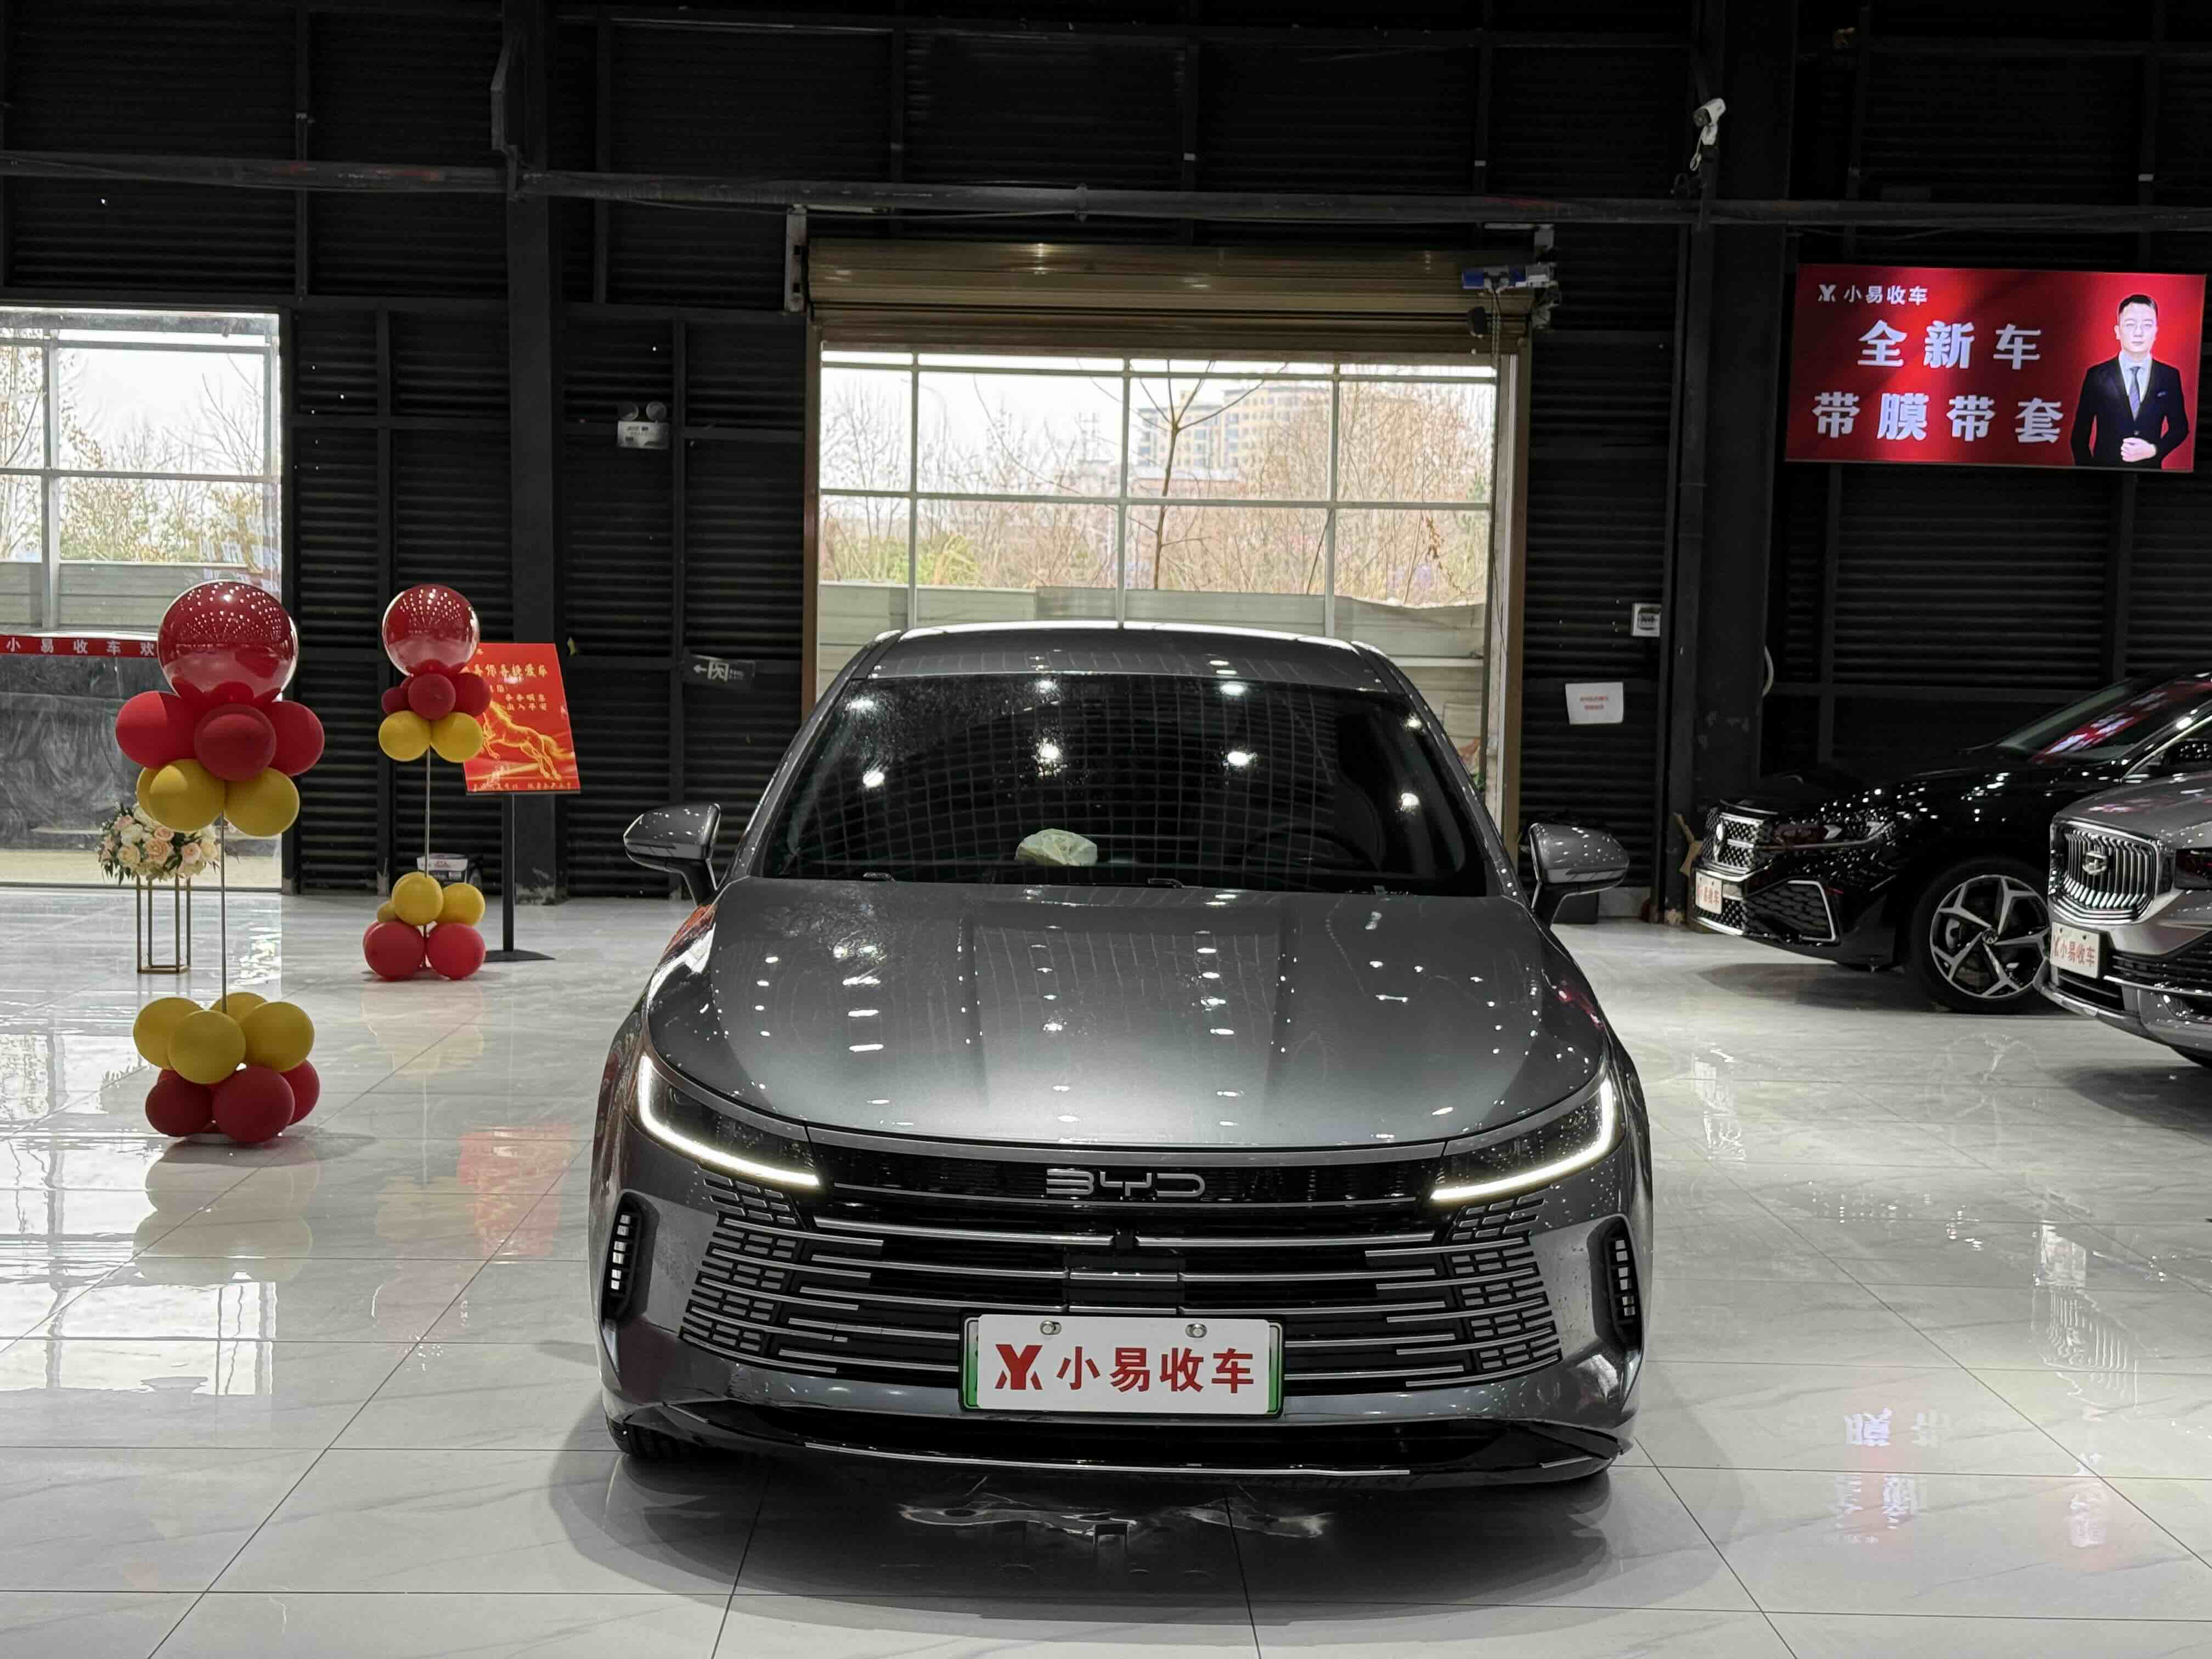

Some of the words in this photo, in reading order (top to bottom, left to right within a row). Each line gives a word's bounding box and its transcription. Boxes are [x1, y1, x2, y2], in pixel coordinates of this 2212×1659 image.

[1844, 285, 1928, 306] 小易收车
[1858, 319, 2041, 370] 全新车
[1813, 391, 2063, 443] 带膜带套
[1047, 1169, 1205, 1198] BYD
[1057, 1346, 1254, 1393] 小易收车
